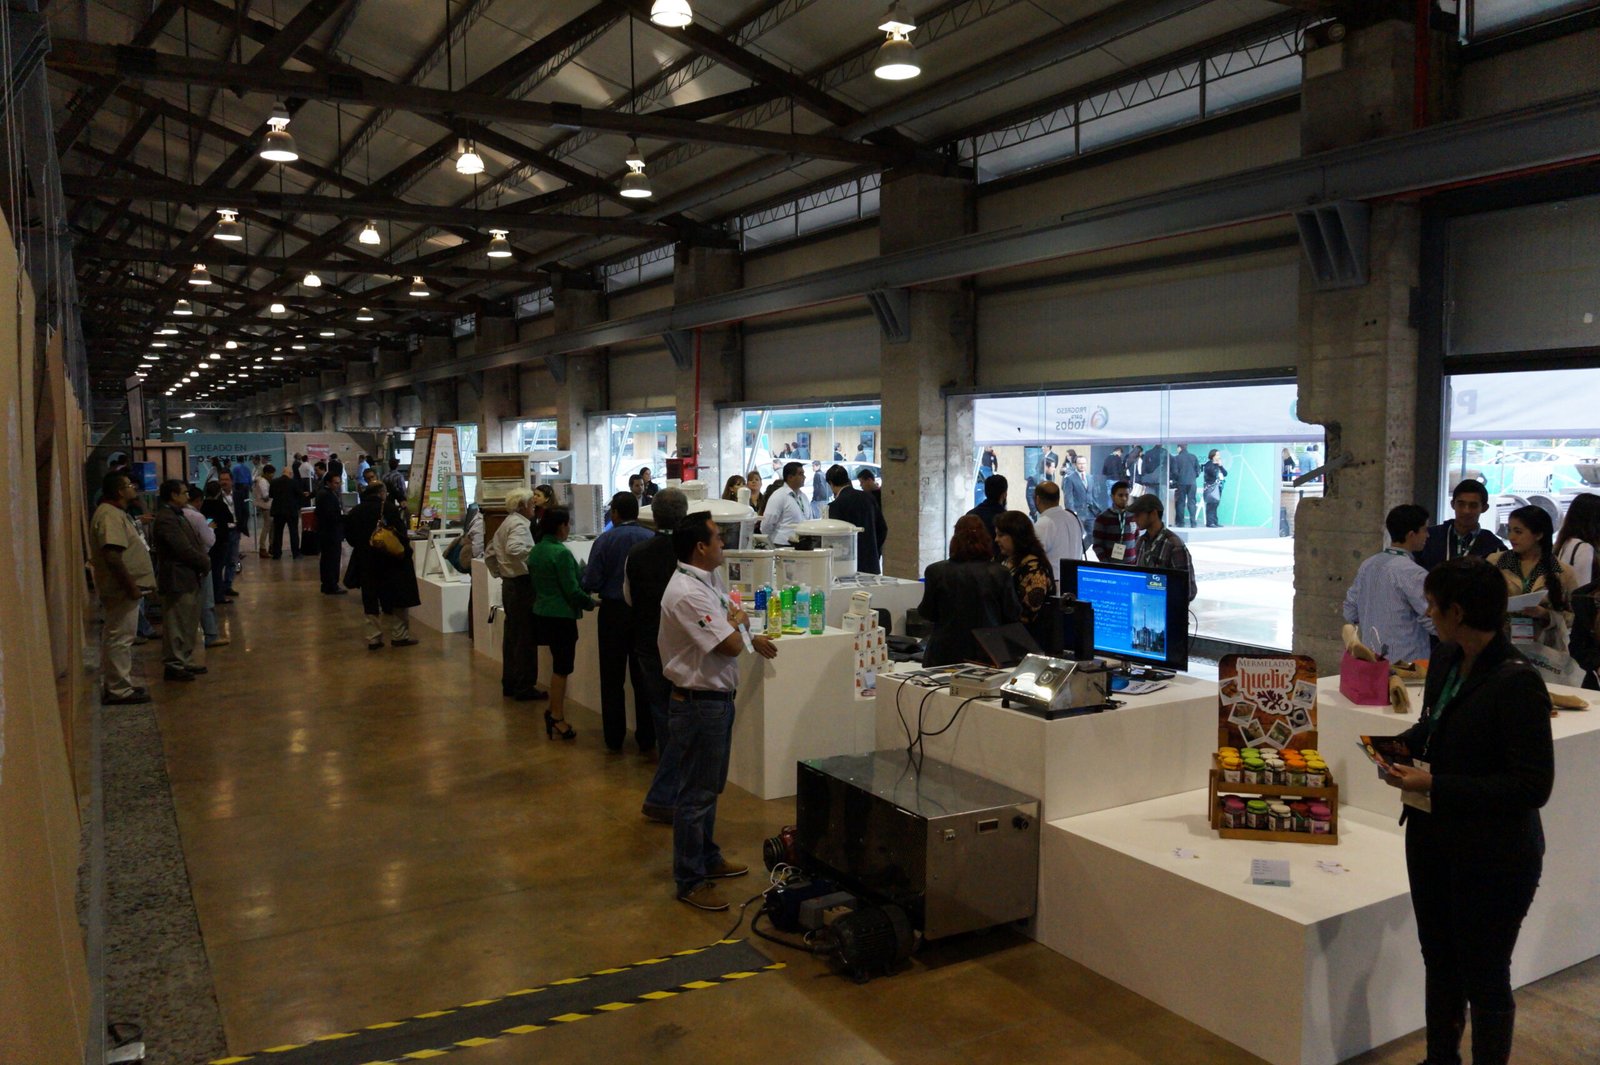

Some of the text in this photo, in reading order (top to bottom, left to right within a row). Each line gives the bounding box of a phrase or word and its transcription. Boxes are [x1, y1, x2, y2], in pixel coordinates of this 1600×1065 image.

[194, 444, 247, 452] CREADO EN
[1238, 660, 1294, 668] MERMELADAS
[1240, 668, 1290, 696] huelic
